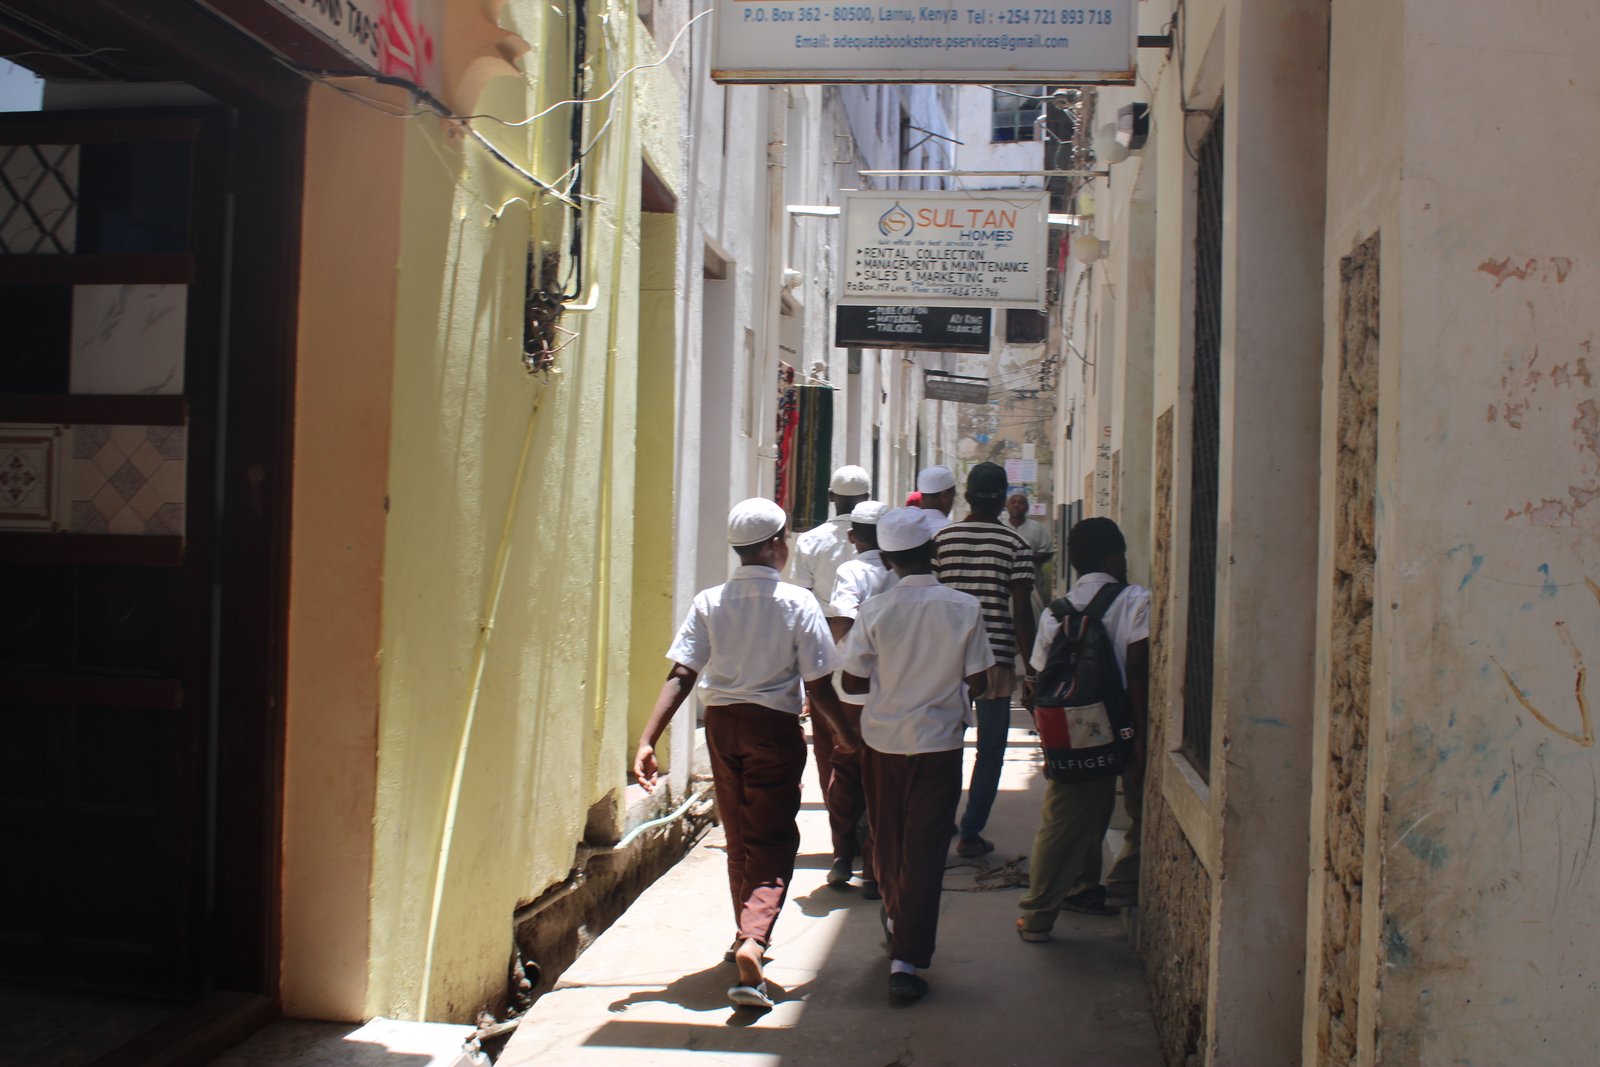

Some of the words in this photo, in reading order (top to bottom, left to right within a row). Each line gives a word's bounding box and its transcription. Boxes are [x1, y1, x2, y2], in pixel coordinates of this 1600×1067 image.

[744, 8, 768, 22] P.O.
[772, 8, 795, 22] Box
[798, 7, 820, 22] 362
[833, 7, 875, 24] 80500,
[879, 6, 916, 24] Lamu,
[919, 6, 958, 25] Kenya
[967, 9, 985, 24] Tel
[997, 9, 1030, 25] +254
[1034, 10, 1056, 24] 721
[1061, 9, 1084, 24] 893
[1088, 9, 1112, 24] 718
[346, 1, 378, 57] TAPS
[795, 35, 829, 48] Email:
[833, 34, 1069, 51] adequatebookstore.pservices@gmail.com
[916, 208, 1018, 229] SULTAN
[960, 230, 1014, 242] HOMES
[864, 248, 909, 259] RENTAL
[916, 248, 985, 260] COLLECTION
[864, 259, 938, 271] MANAGEMENT
[942, 261, 948, 271] &
[951, 261, 1029, 273] MAINTENANCE
[864, 270, 898, 281] SALES
[905, 271, 912, 281] &
[917, 271, 984, 283] MARKETING
[876, 314, 919, 324] MATERIAL
[876, 323, 923, 334] TAILORING
[1050, 754, 1116, 769] ILFIGER
